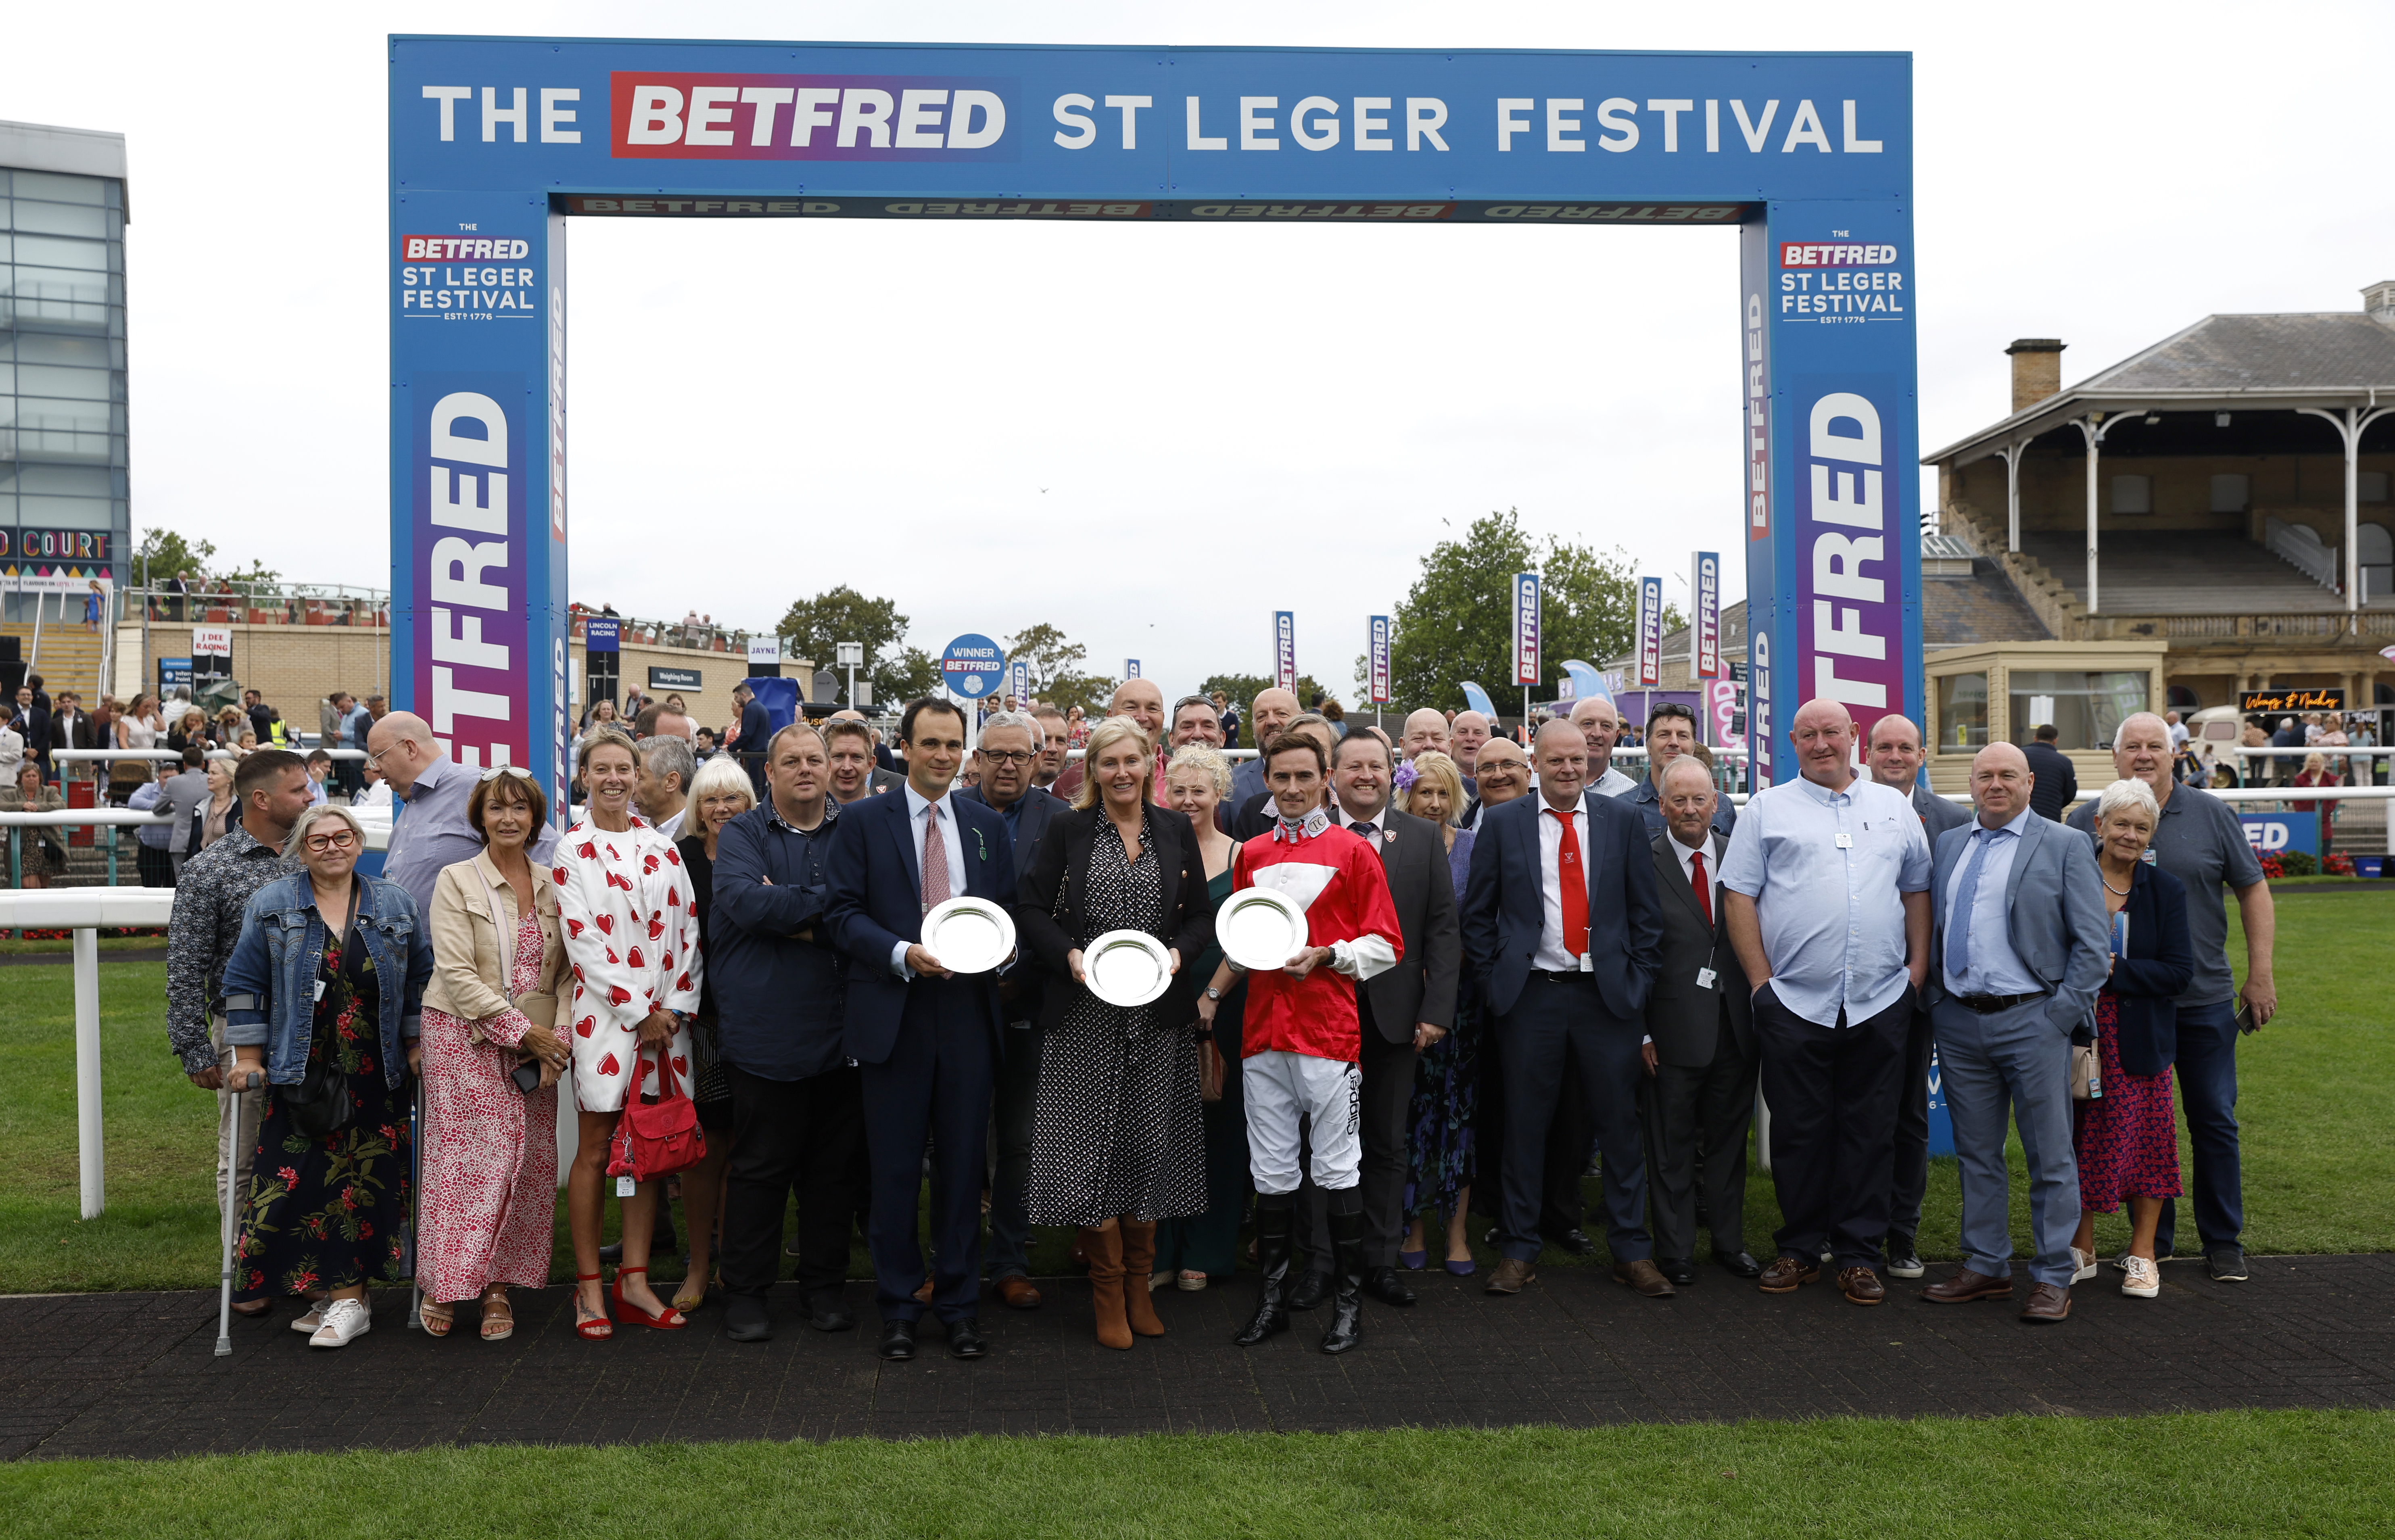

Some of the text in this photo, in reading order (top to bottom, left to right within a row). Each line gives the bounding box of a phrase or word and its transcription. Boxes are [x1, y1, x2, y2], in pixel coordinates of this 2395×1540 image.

[422, 85, 1883, 153] THE BETFRED ST LEGER FESTIVAL
[583, 199, 840, 213] BETFRED
[885, 203, 1141, 215] BETFRED
[1191, 205, 1446, 217] BETFRED
[1485, 206, 1737, 220] BETFRED
[407, 238, 529, 259] BETFRED
[1785, 244, 1897, 265] BETFRED
[403, 267, 534, 286] ST LEGER
[1781, 272, 1902, 291] ST LEGER
[404, 290, 534, 309] FESTIVAL
[1782, 294, 1903, 313] FESTIVAL
[553, 287, 563, 534] BETFRED
[1748, 293, 1766, 528] BETFRED
[23, 530, 108, 558] COURT
[1810, 392, 1887, 709] TFRED
[431, 392, 510, 768] TFRED
[1701, 558, 1716, 672] BETFRED
[589, 622, 618, 630] LINCOLN
[1521, 580, 1535, 680] BETFRED
[1643, 582, 1658, 680] BETFRED
[196, 643, 228, 651] RACING
[202, 633, 206, 642] J
[751, 646, 777, 655] JAYNE
[952, 647, 994, 658] WINNER
[1373, 619, 1386, 699] BETFRED
[946, 661, 1000, 671] BETFRED
[659, 672, 681, 682] Weighing
[2299, 689, 2339, 710] Nachos
[1755, 632, 1770, 792] TFRED
[555, 637, 565, 837] ETFRED
[1310, 816, 1325, 831] TC
[1347, 1075, 1359, 1135] Clipper
